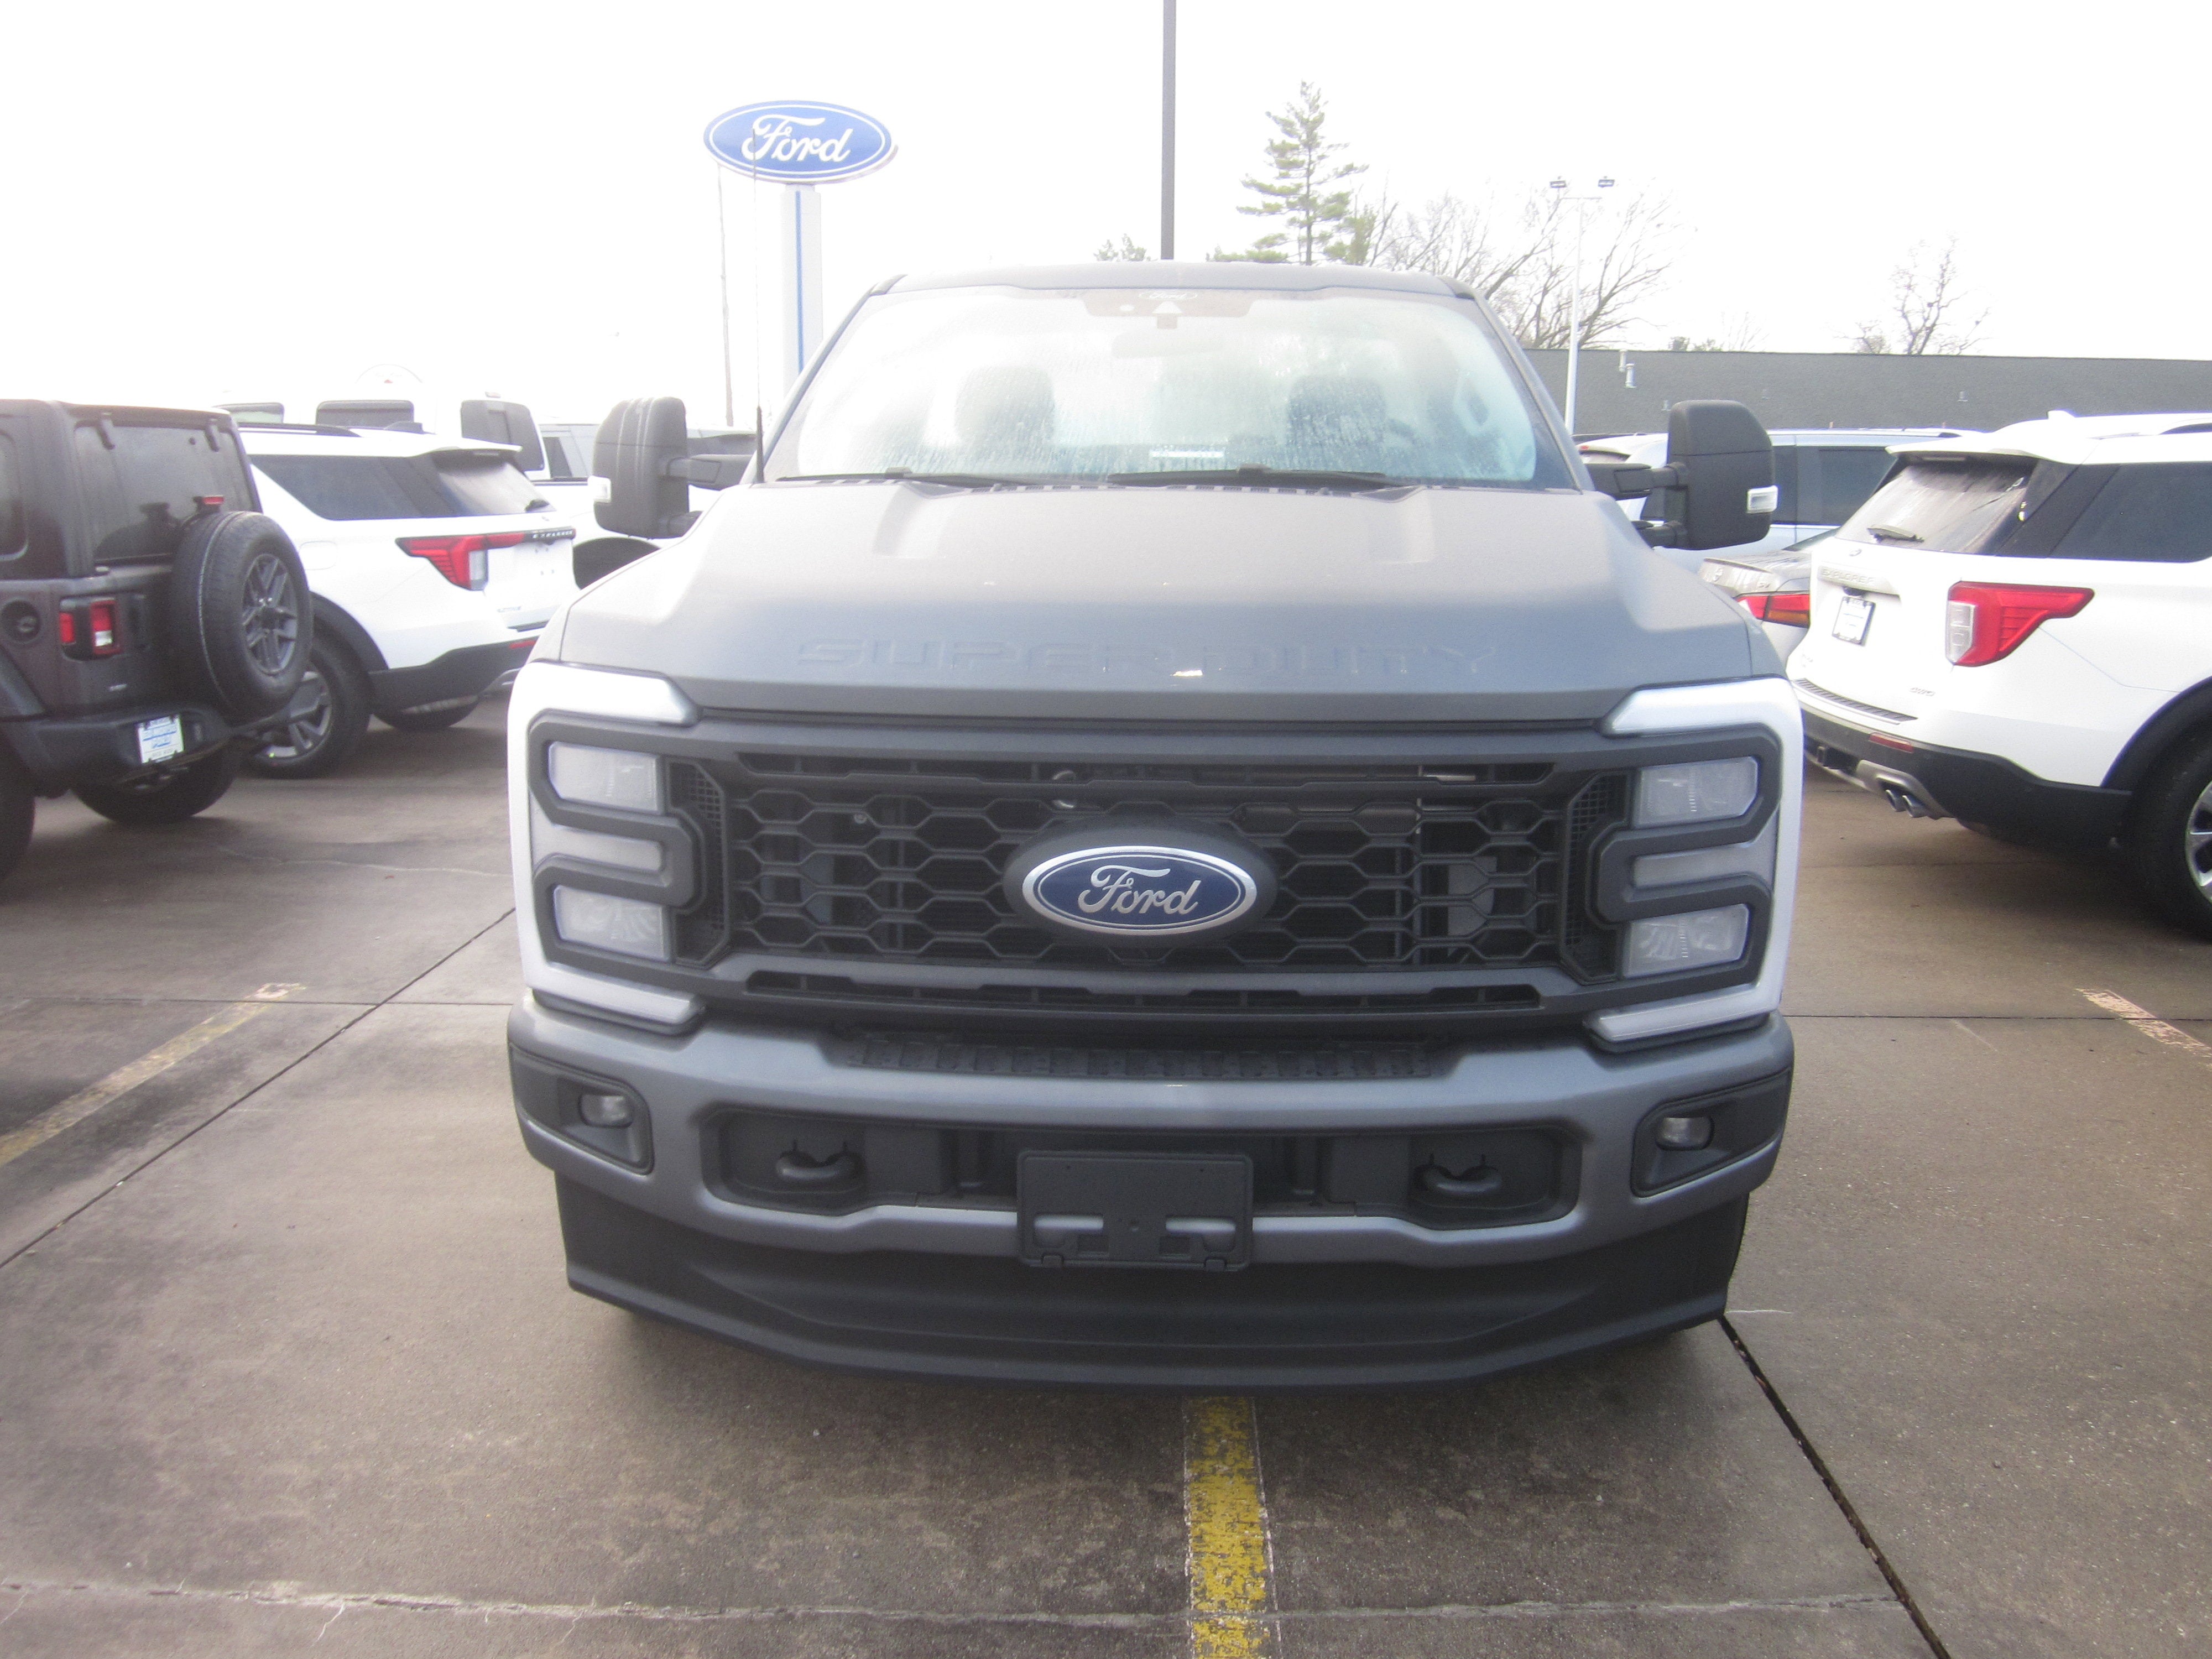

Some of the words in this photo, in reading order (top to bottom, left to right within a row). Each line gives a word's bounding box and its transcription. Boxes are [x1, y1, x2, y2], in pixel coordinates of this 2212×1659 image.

[741, 114, 853, 162] Ford
[796, 638, 1172, 676] SUPER
[1202, 645, 1499, 677] DUTY
[1077, 864, 1202, 915] Ford
